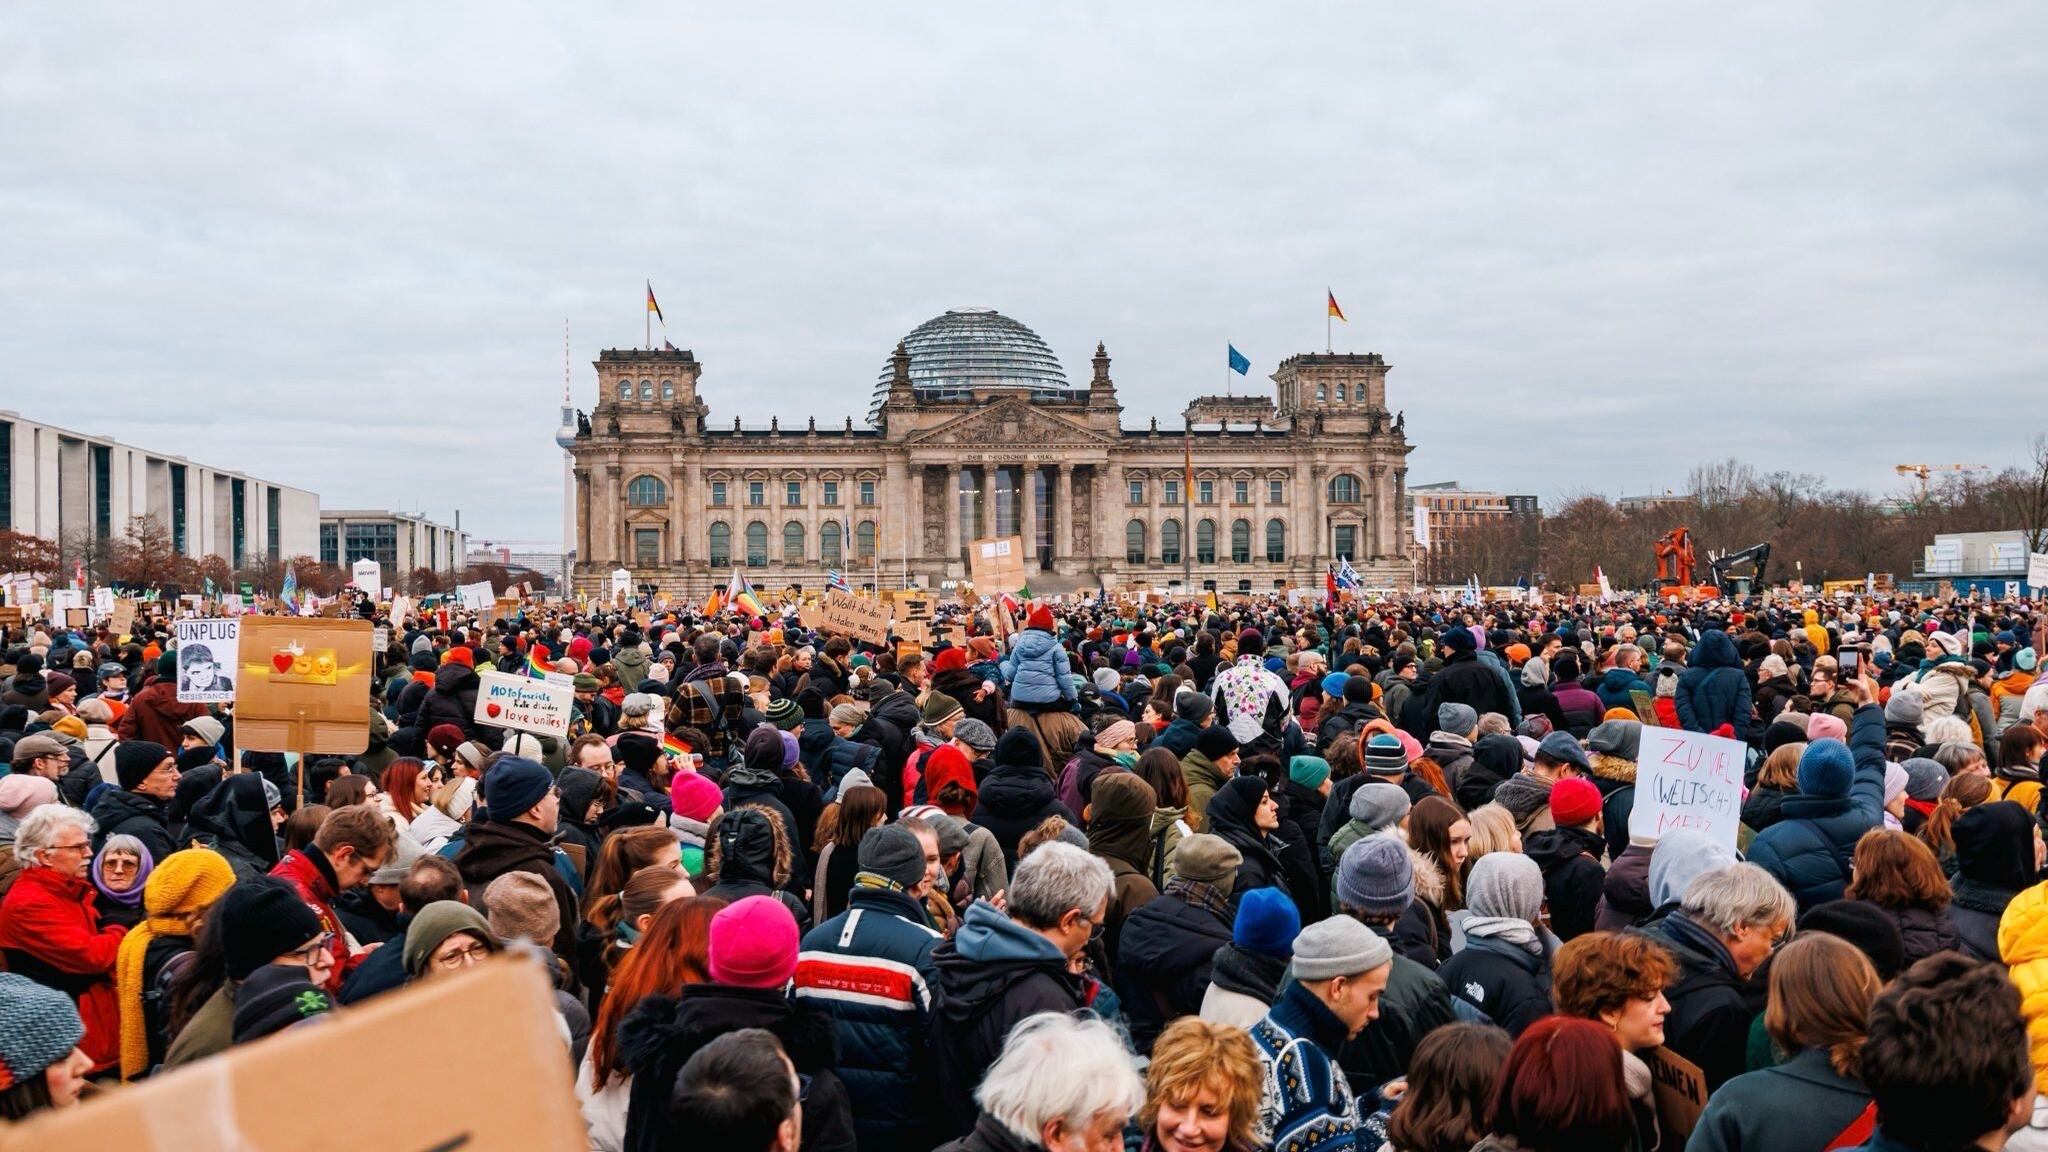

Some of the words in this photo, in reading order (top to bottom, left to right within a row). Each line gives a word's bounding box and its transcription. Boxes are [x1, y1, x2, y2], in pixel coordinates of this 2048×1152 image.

[832, 592, 857, 611] Wollt
[857, 603, 867, 614] ihr
[868, 606, 881, 618] den
[829, 612, 855, 628] totalen
[180, 623, 236, 640] UNPLUG
[505, 708, 529, 723] love
[1661, 739, 1703, 772] ZU
